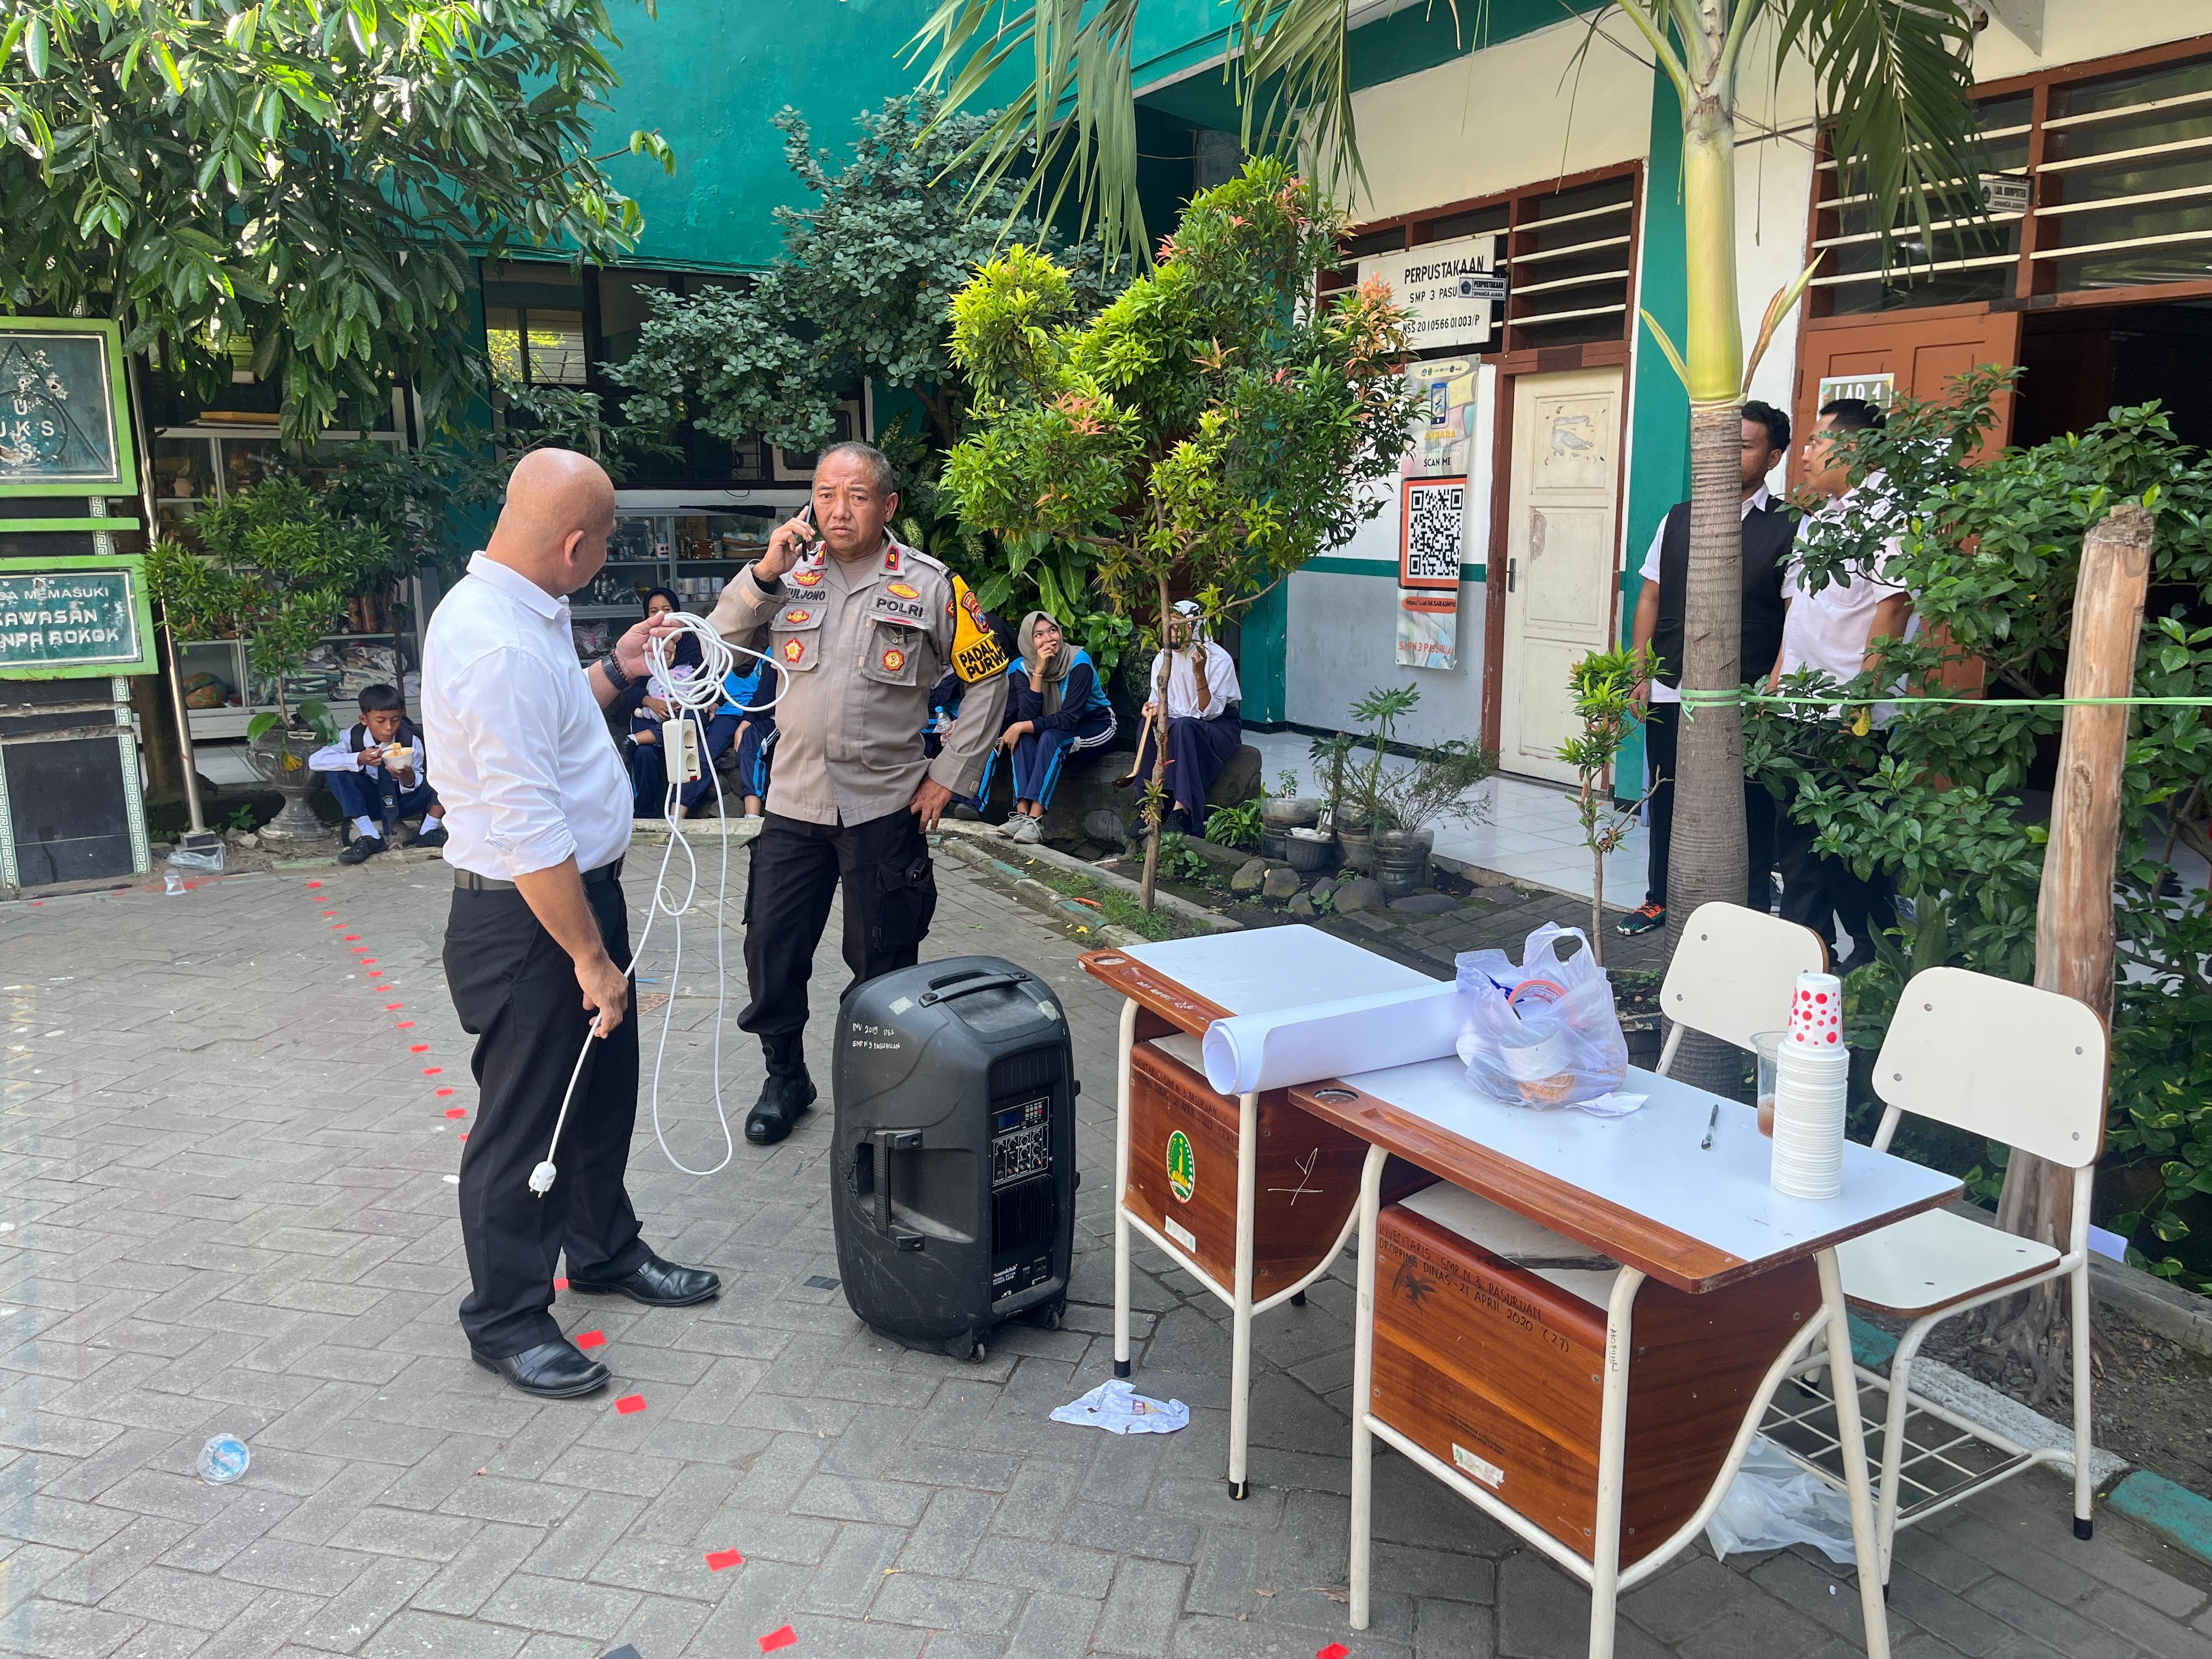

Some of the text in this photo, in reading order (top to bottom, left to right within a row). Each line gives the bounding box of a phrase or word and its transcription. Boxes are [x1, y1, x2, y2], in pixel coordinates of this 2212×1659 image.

[1404, 256, 1484, 284] PERPUSTAKAAN
[1410, 291, 1426, 303] SMP
[1430, 290, 1435, 301] 3
[14, 399, 27, 415] U
[20, 443, 33, 460] S
[1424, 457, 1451, 467] SCAN ME
[24, 588, 110, 600] MEMASUKI
[788, 588, 826, 601] ULJONO
[877, 598, 923, 618] POLRI
[48, 628, 119, 646] ROKOK
[960, 640, 994, 668] PADAL
[1399, 641, 1417, 651] SMPN
[1418, 642, 1423, 652] 3
[853, 1023, 862, 1031] INV
[1379, 1223, 1431, 1260] INVENTARIS
[1441, 1257, 1459, 1276] SMP
[1463, 1269, 1470, 1282] N
[1489, 1283, 1541, 1322] PASURUAN
[1379, 1237, 1418, 1268] DROPPING
[1474, 1291, 1502, 1313] APRIL
[1507, 1309, 1533, 1331] 2020
[1543, 1329, 1570, 1353] (27)
